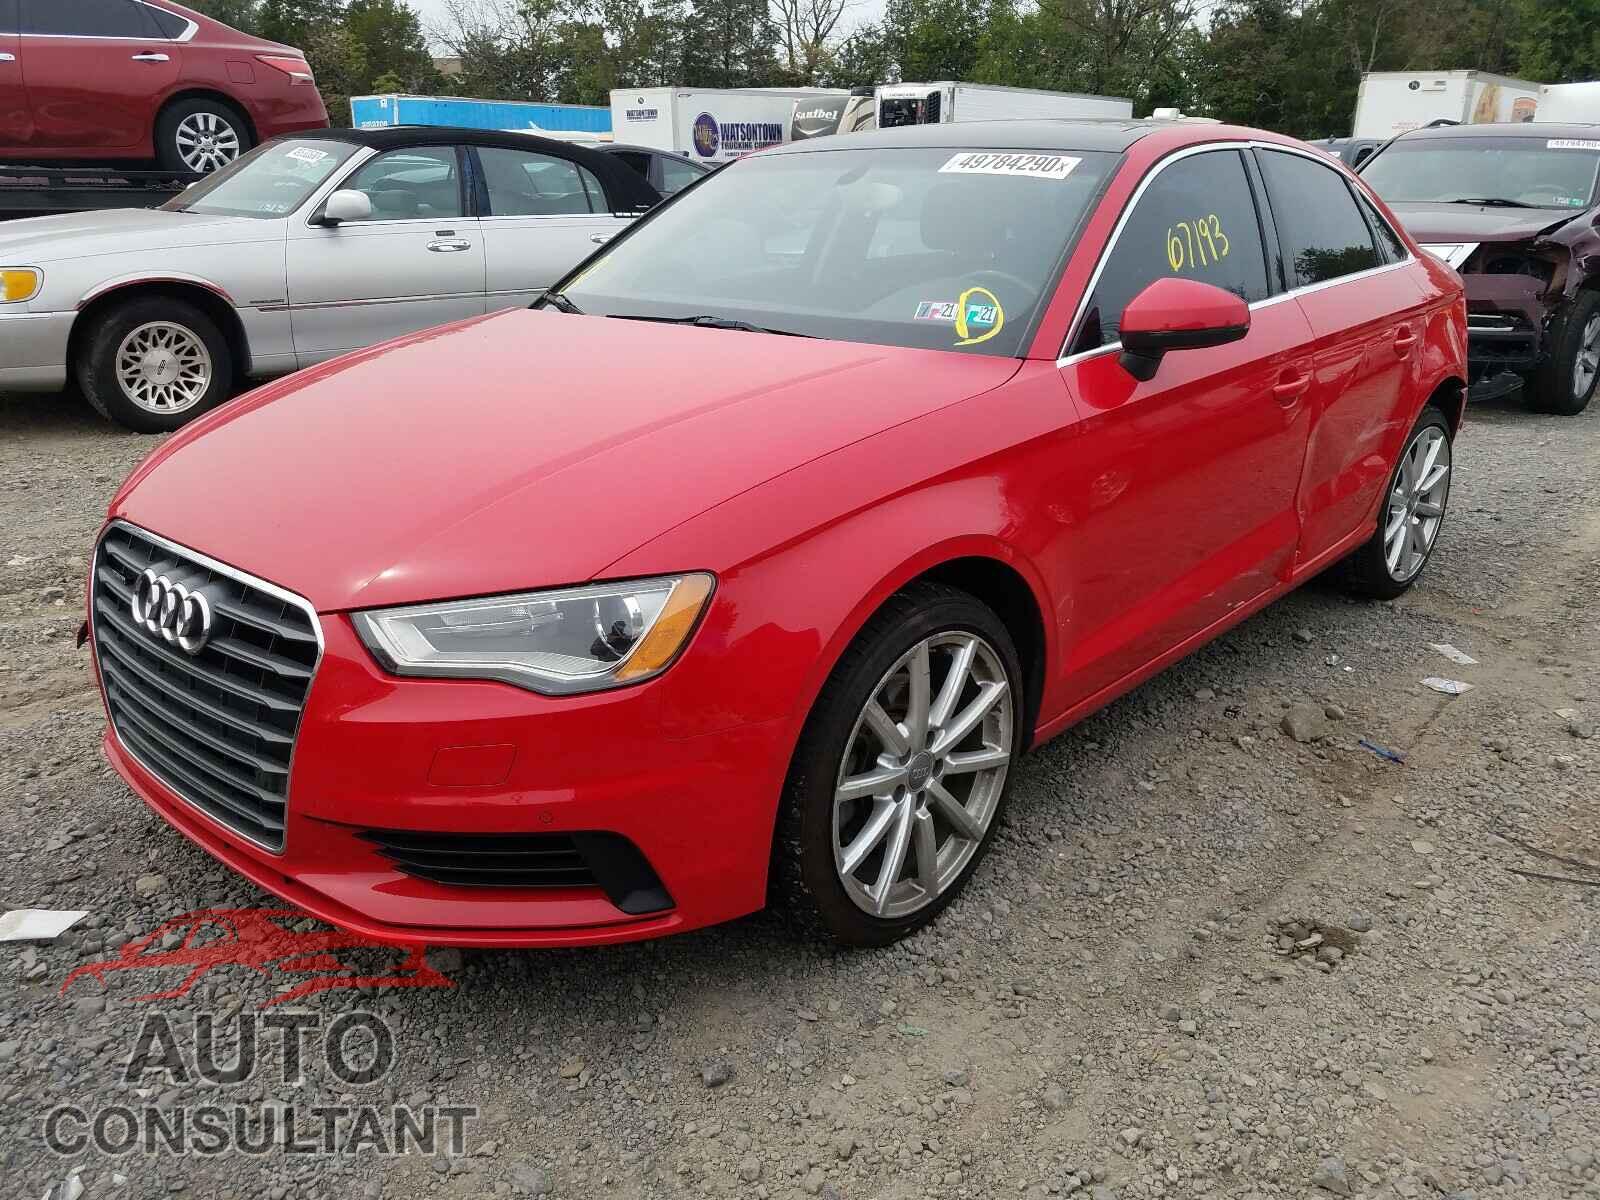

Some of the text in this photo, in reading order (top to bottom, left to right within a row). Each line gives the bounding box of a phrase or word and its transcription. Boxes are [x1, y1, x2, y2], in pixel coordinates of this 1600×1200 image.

[719, 122, 782, 142] WATSONTOWN
[721, 141, 752, 150] TRUCKING
[1167, 214, 1229, 272] 67193
